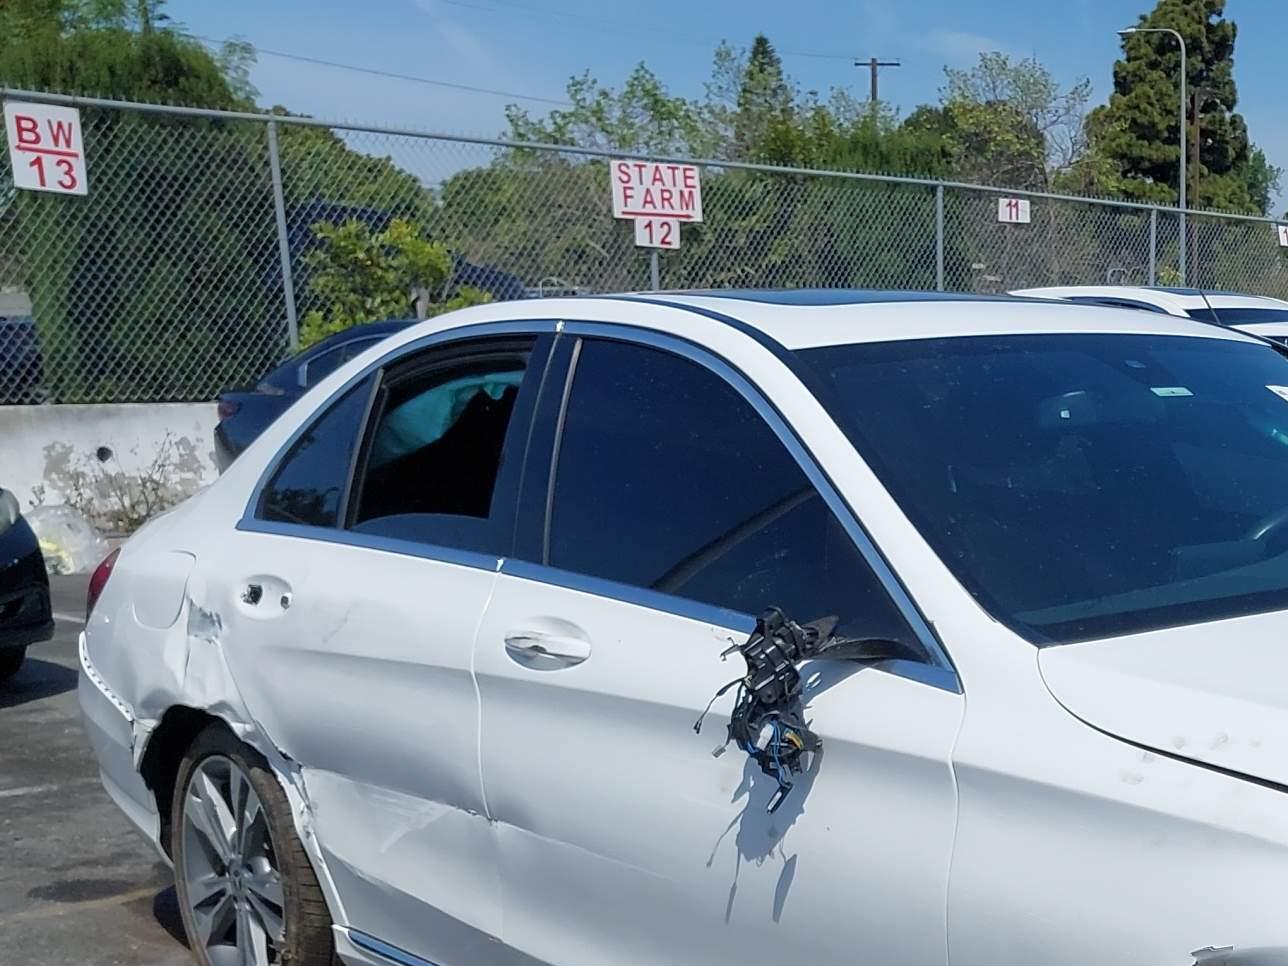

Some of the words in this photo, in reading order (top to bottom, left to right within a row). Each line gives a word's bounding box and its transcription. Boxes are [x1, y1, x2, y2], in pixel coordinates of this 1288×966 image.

[15, 115, 72, 148] BW
[29, 156, 77, 189] 13
[618, 162, 696, 188] STATE
[623, 186, 695, 210] FARM
[1006, 200, 1019, 220] 11
[644, 220, 672, 245] 12
